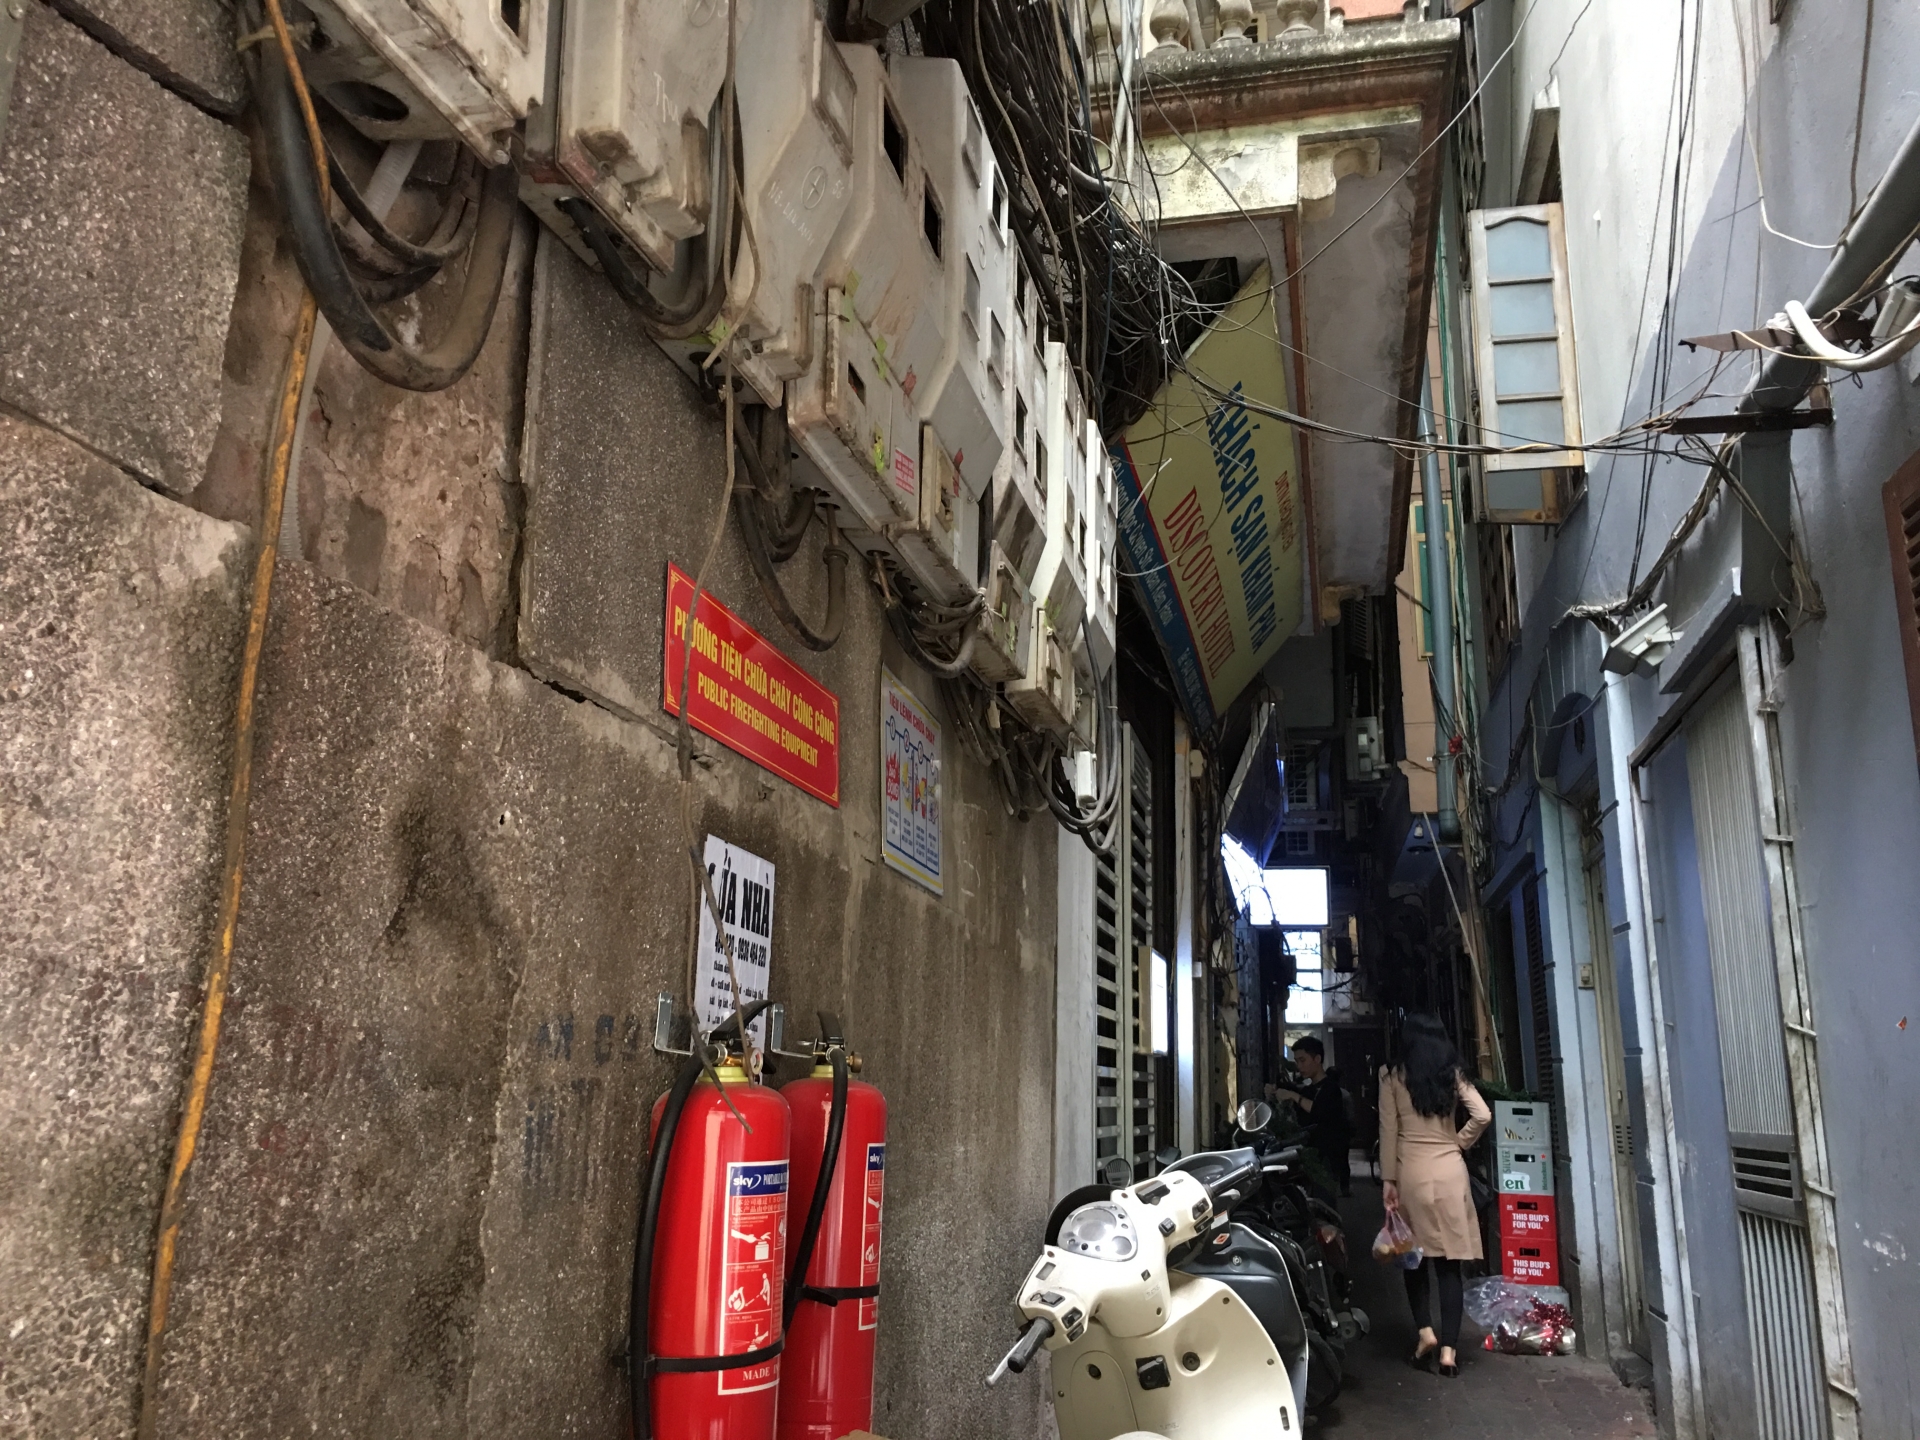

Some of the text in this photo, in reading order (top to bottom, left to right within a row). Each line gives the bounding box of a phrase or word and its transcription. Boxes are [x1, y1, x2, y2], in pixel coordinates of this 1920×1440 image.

[1205, 380, 1283, 655] KHÁCH SẠN KHÁM PHÁ
[1163, 485, 1226, 629] DISCOVERY
[1201, 609, 1235, 679] HOTEL
[721, 639, 742, 681] TIỆN
[744, 658, 767, 700] CHỮA
[770, 677, 791, 714] CHÁY
[793, 692, 814, 731] CÔNG
[815, 709, 834, 745] CỘNG
[698, 671, 818, 768] PUBLIC FIREFIGHTING EQUIPMENT
[741, 872, 770, 938] NHÀ
[870, 1154, 880, 1164] sky
[1502, 1150, 1511, 1174] SILVER
[733, 1175, 753, 1187] sky
[1505, 1179, 1525, 1189] en
[1512, 1213, 1549, 1222] THIS BUD'S
[1513, 1259, 1550, 1269] THIS BUD'S
[742, 1367, 770, 1380] MADE
